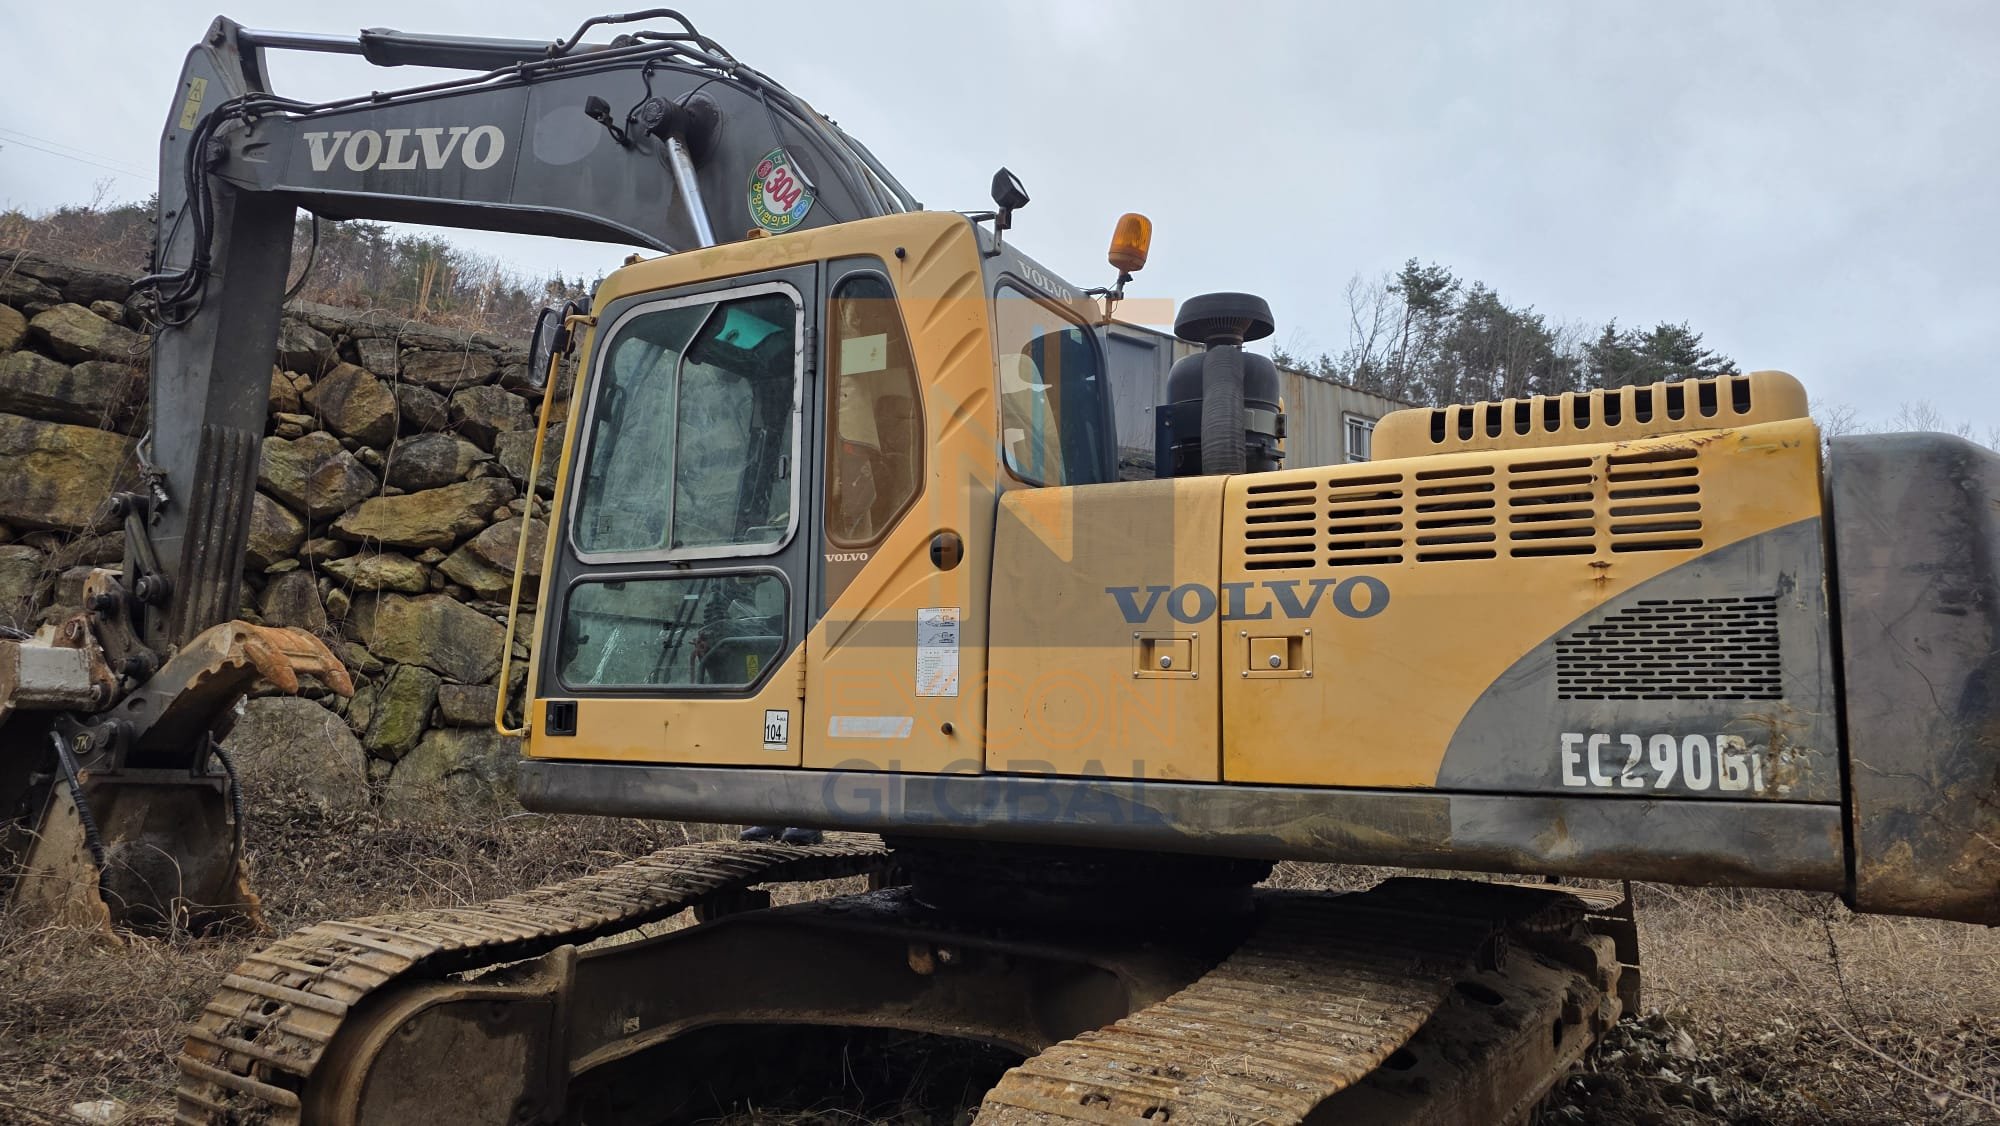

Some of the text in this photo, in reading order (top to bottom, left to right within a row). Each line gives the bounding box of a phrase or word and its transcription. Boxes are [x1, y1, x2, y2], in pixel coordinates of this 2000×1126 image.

[303, 125, 505, 172] VOLVO
[765, 168, 802, 212] 304
[1017, 259, 1073, 305] VOLVO
[824, 552, 868, 562] VOLVO
[1105, 575, 1390, 624] VOLVO
[766, 723, 782, 741] 104
